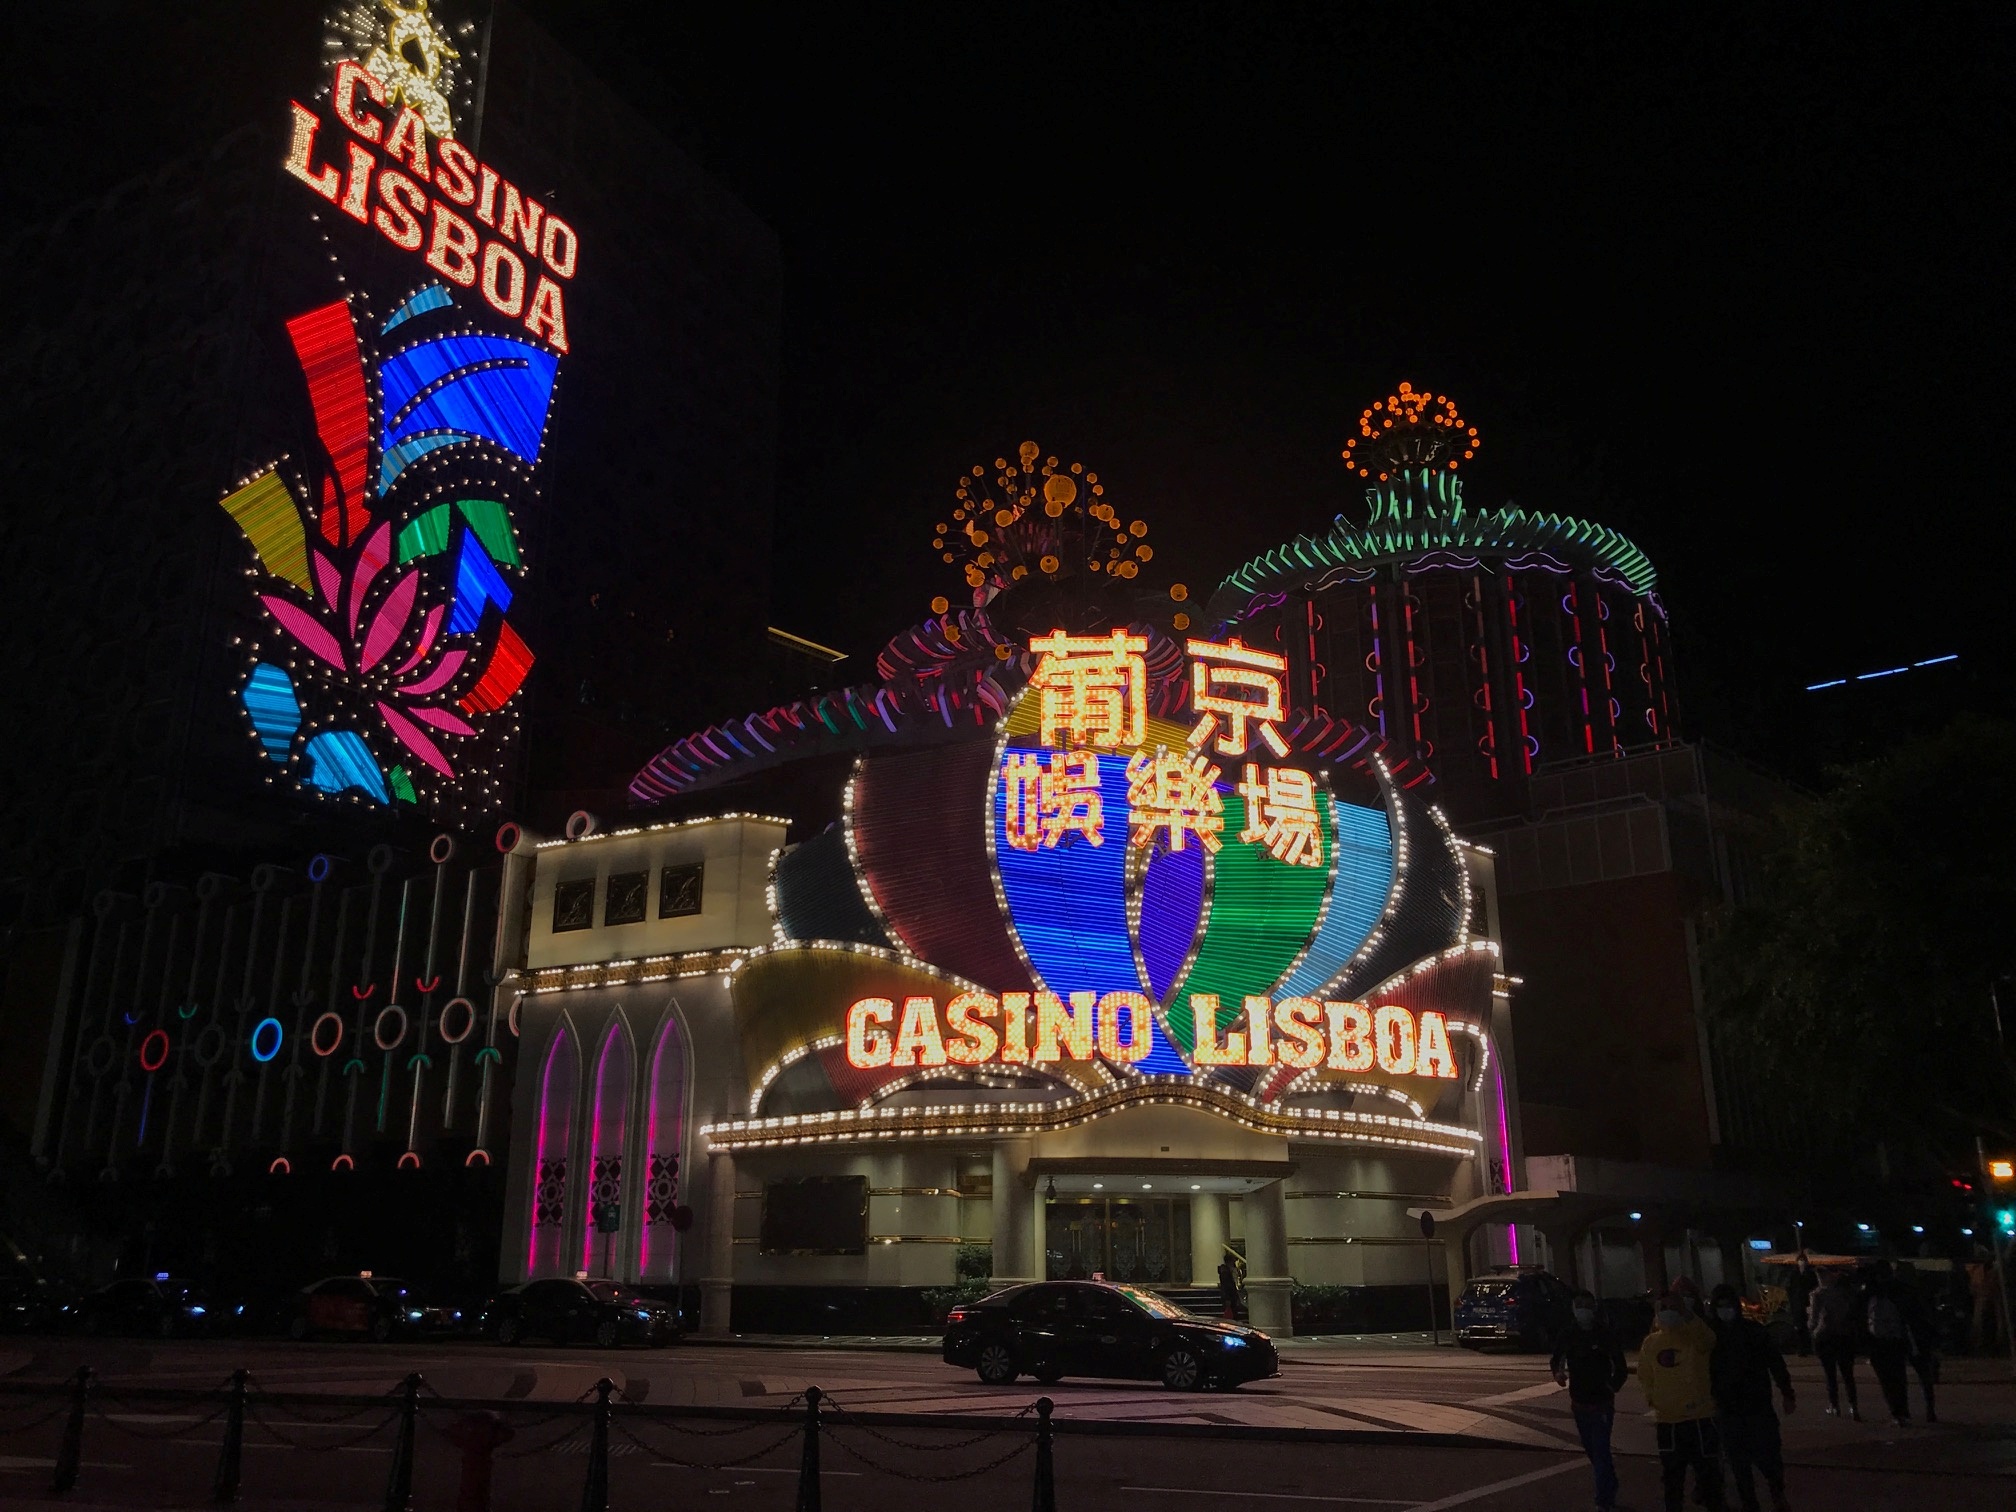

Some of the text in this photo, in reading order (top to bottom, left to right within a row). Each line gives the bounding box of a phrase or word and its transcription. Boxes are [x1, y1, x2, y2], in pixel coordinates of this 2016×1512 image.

[285, 100, 569, 354] LISBOA
[333, 60, 578, 279] CASINO
[1027, 628, 1291, 758] 葡京
[846, 991, 1458, 1079] CASINO LISBOA
